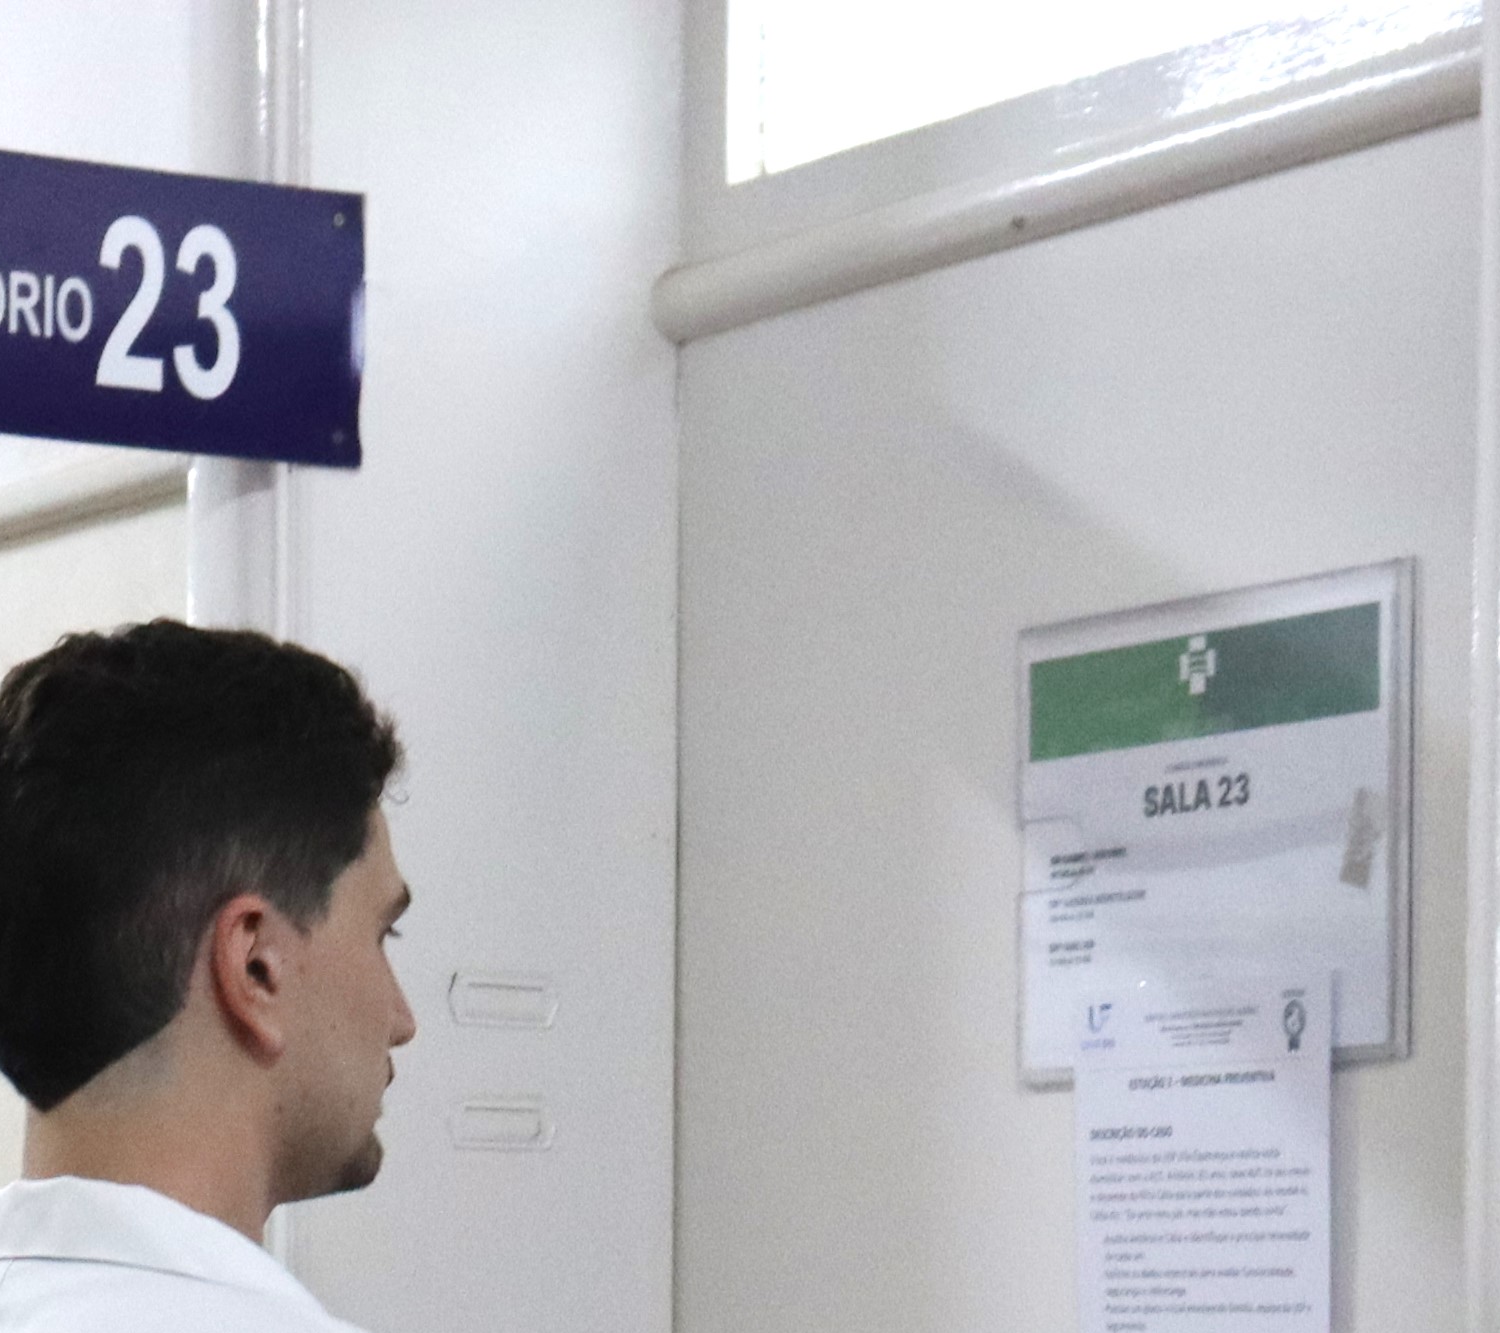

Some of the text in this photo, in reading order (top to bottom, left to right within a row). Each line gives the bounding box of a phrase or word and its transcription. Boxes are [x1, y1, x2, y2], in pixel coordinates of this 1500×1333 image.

[95, 215, 241, 400] 23
[1143, 771, 1251, 818] SALA 23
